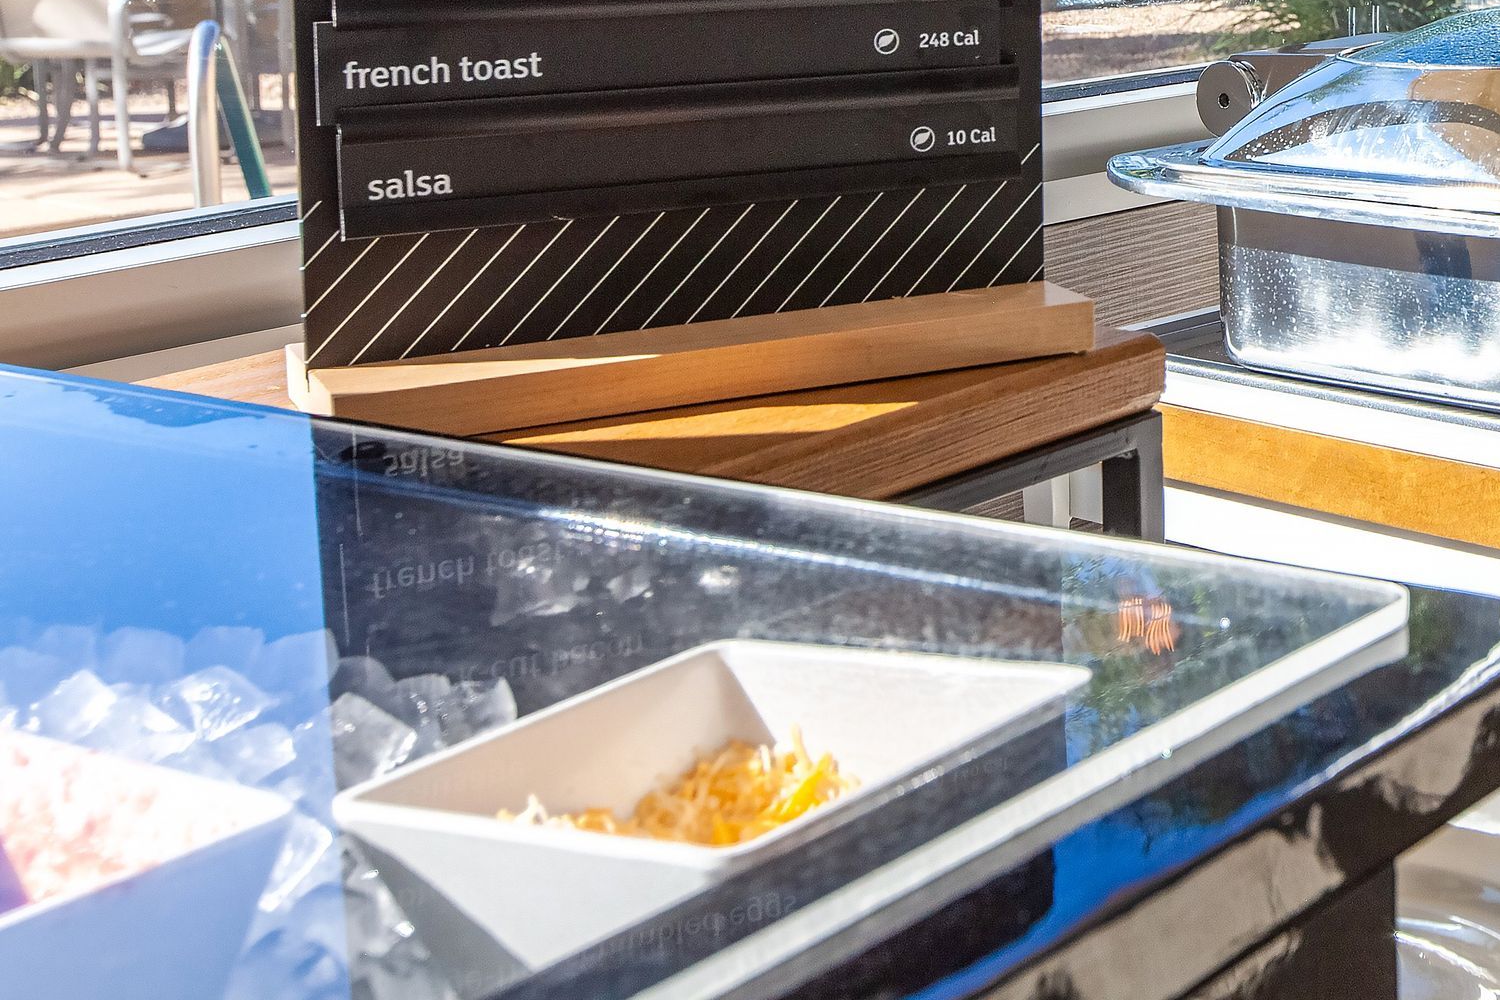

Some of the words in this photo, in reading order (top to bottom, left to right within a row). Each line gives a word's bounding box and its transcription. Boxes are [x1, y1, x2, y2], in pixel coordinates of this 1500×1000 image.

[919, 31, 950, 49] 248
[953, 29, 980, 47] Cal
[342, 56, 451, 90] french
[458, 51, 544, 82] toast
[947, 129, 965, 146] 10
[968, 126, 996, 144] Cal
[367, 169, 454, 201] salsa
